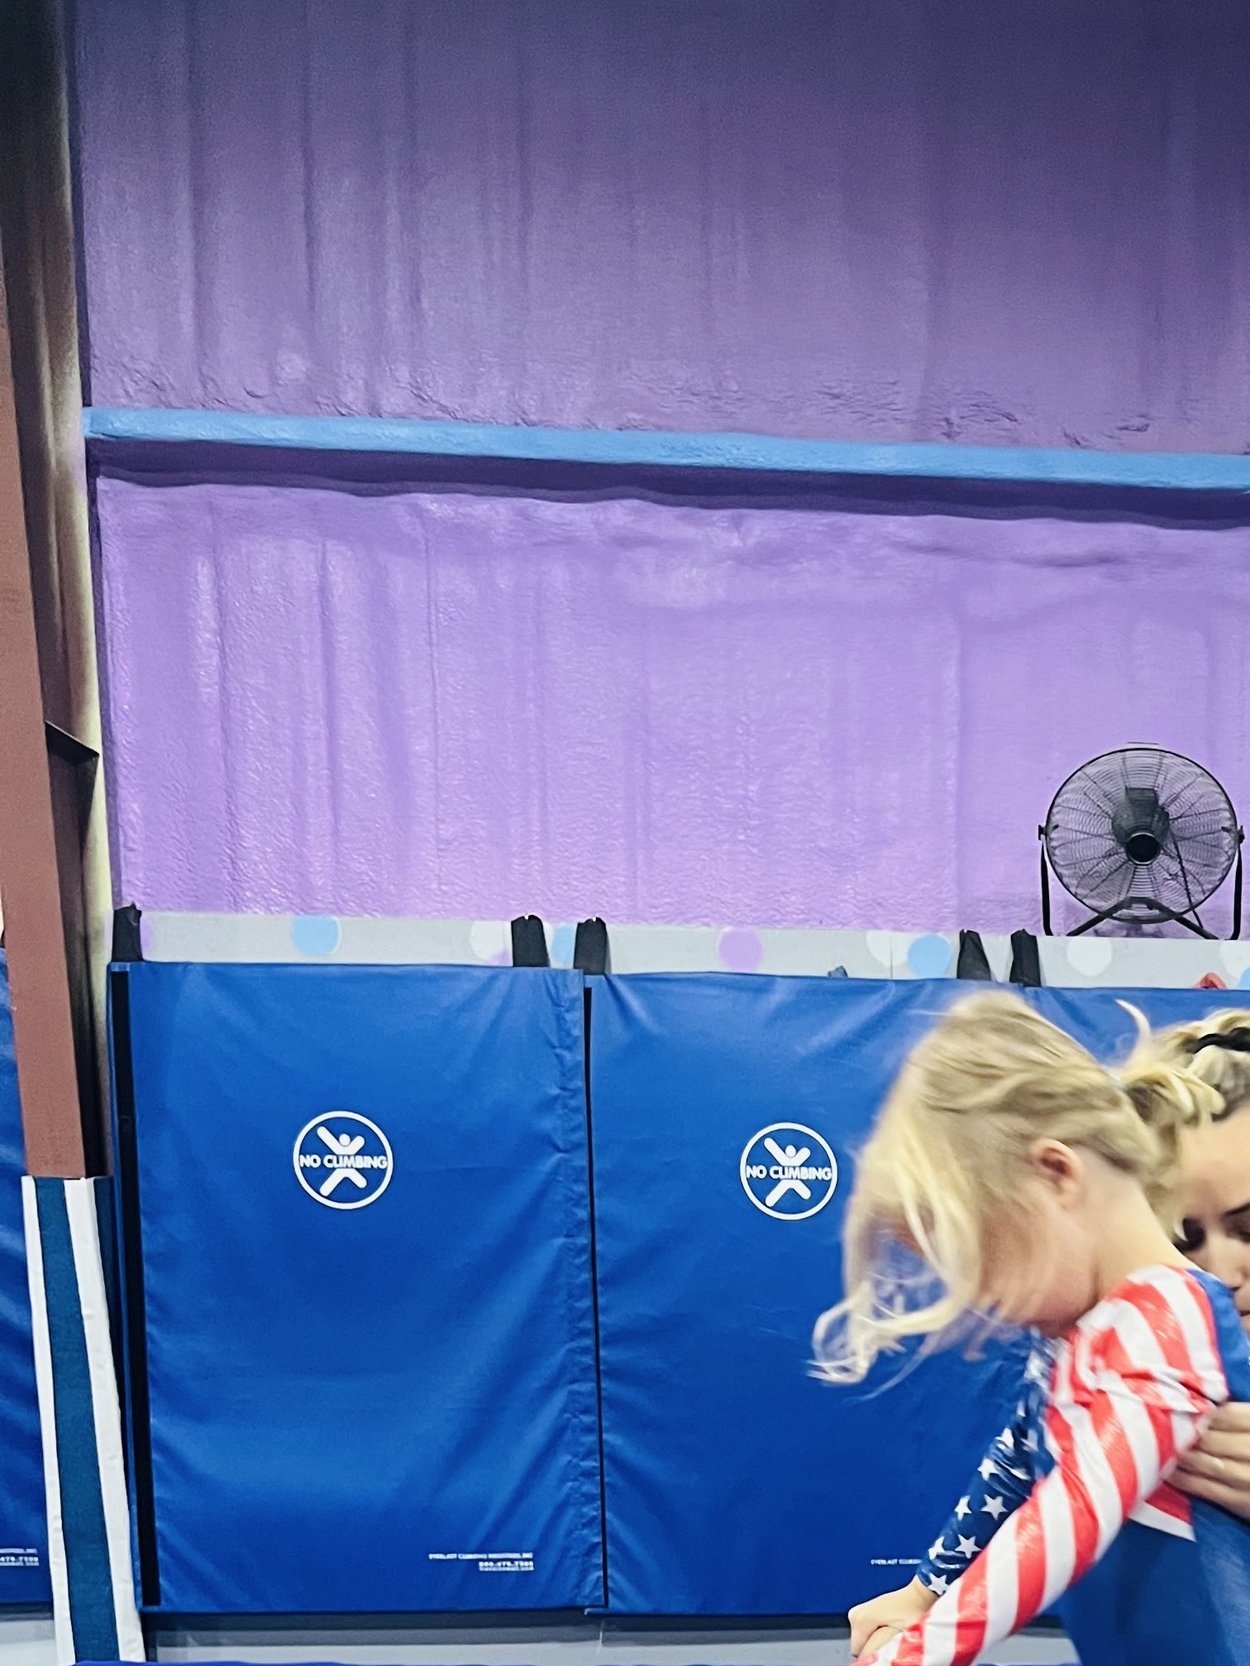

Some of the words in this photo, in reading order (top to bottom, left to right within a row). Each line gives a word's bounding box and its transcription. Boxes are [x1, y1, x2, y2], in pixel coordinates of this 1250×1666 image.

[299, 1154, 322, 1168] NO
[323, 1154, 388, 1169] CLIMBING
[746, 1165, 768, 1179] NO
[769, 1166, 833, 1181] CLIMBING
